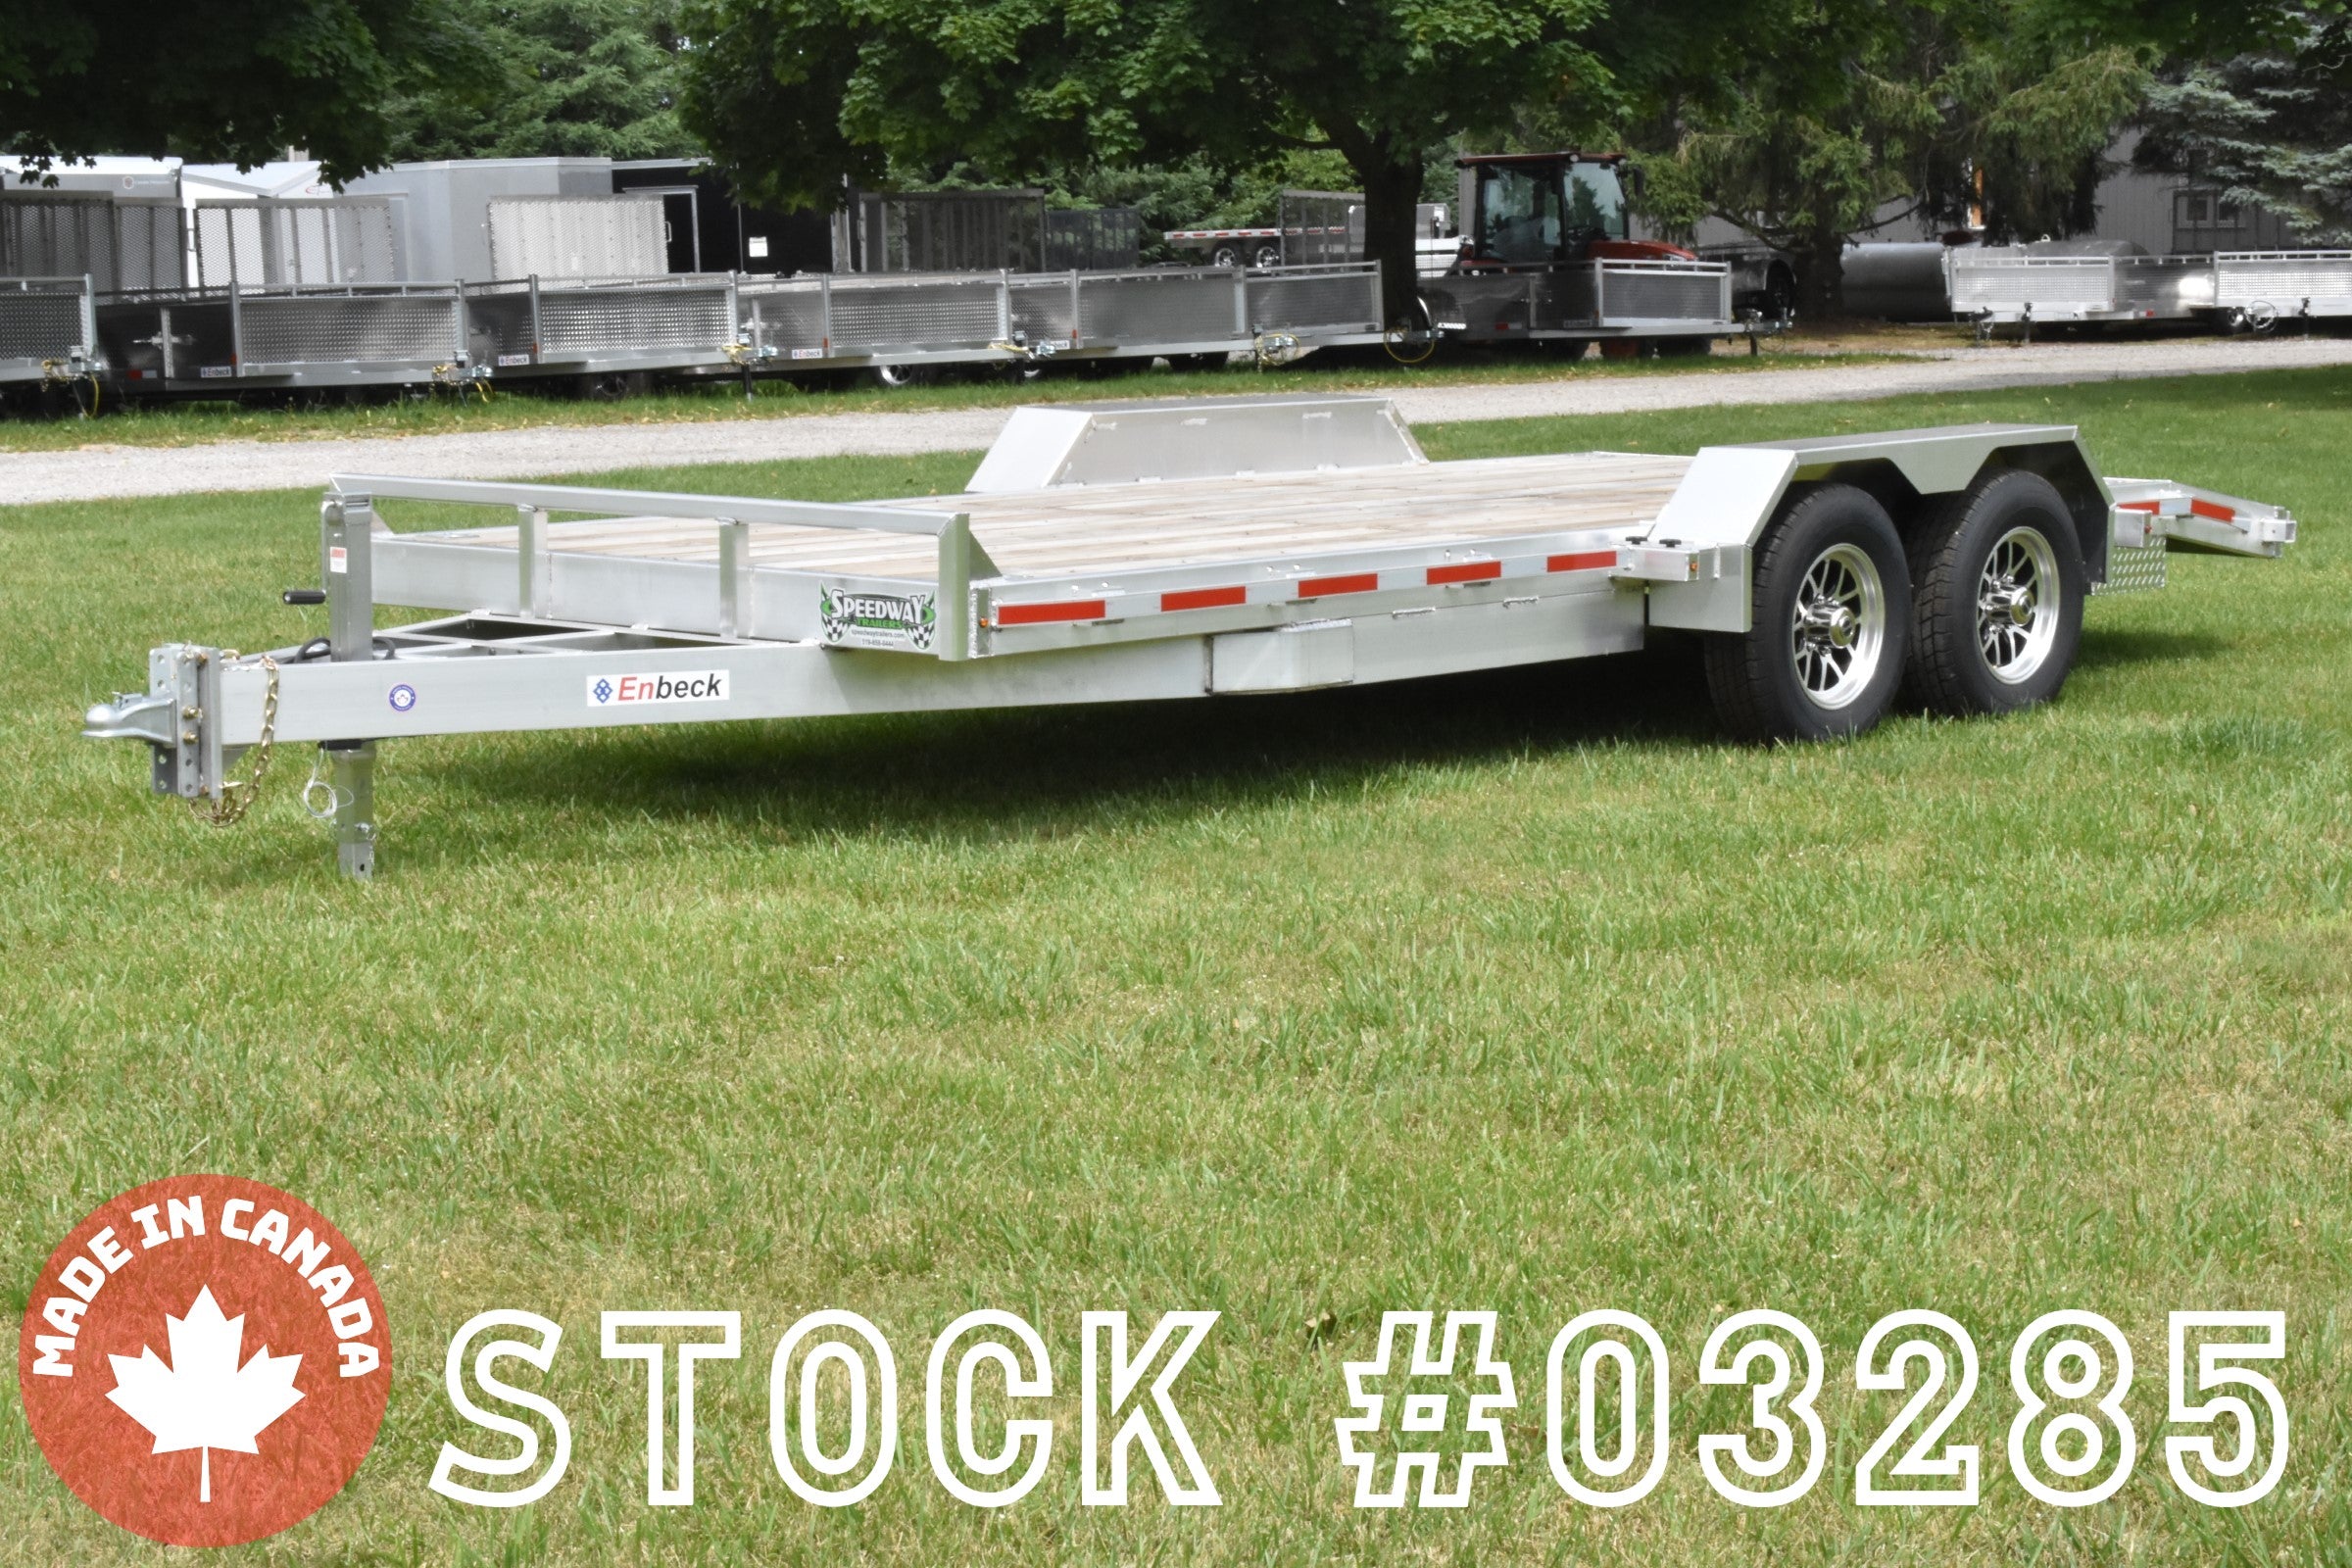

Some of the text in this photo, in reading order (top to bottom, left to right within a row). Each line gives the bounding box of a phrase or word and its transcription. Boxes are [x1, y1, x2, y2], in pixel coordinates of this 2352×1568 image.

[830, 589, 926, 625] SPEEDWAY
[858, 618, 902, 629] TRAILERS
[617, 673, 722, 701] Enbeck
